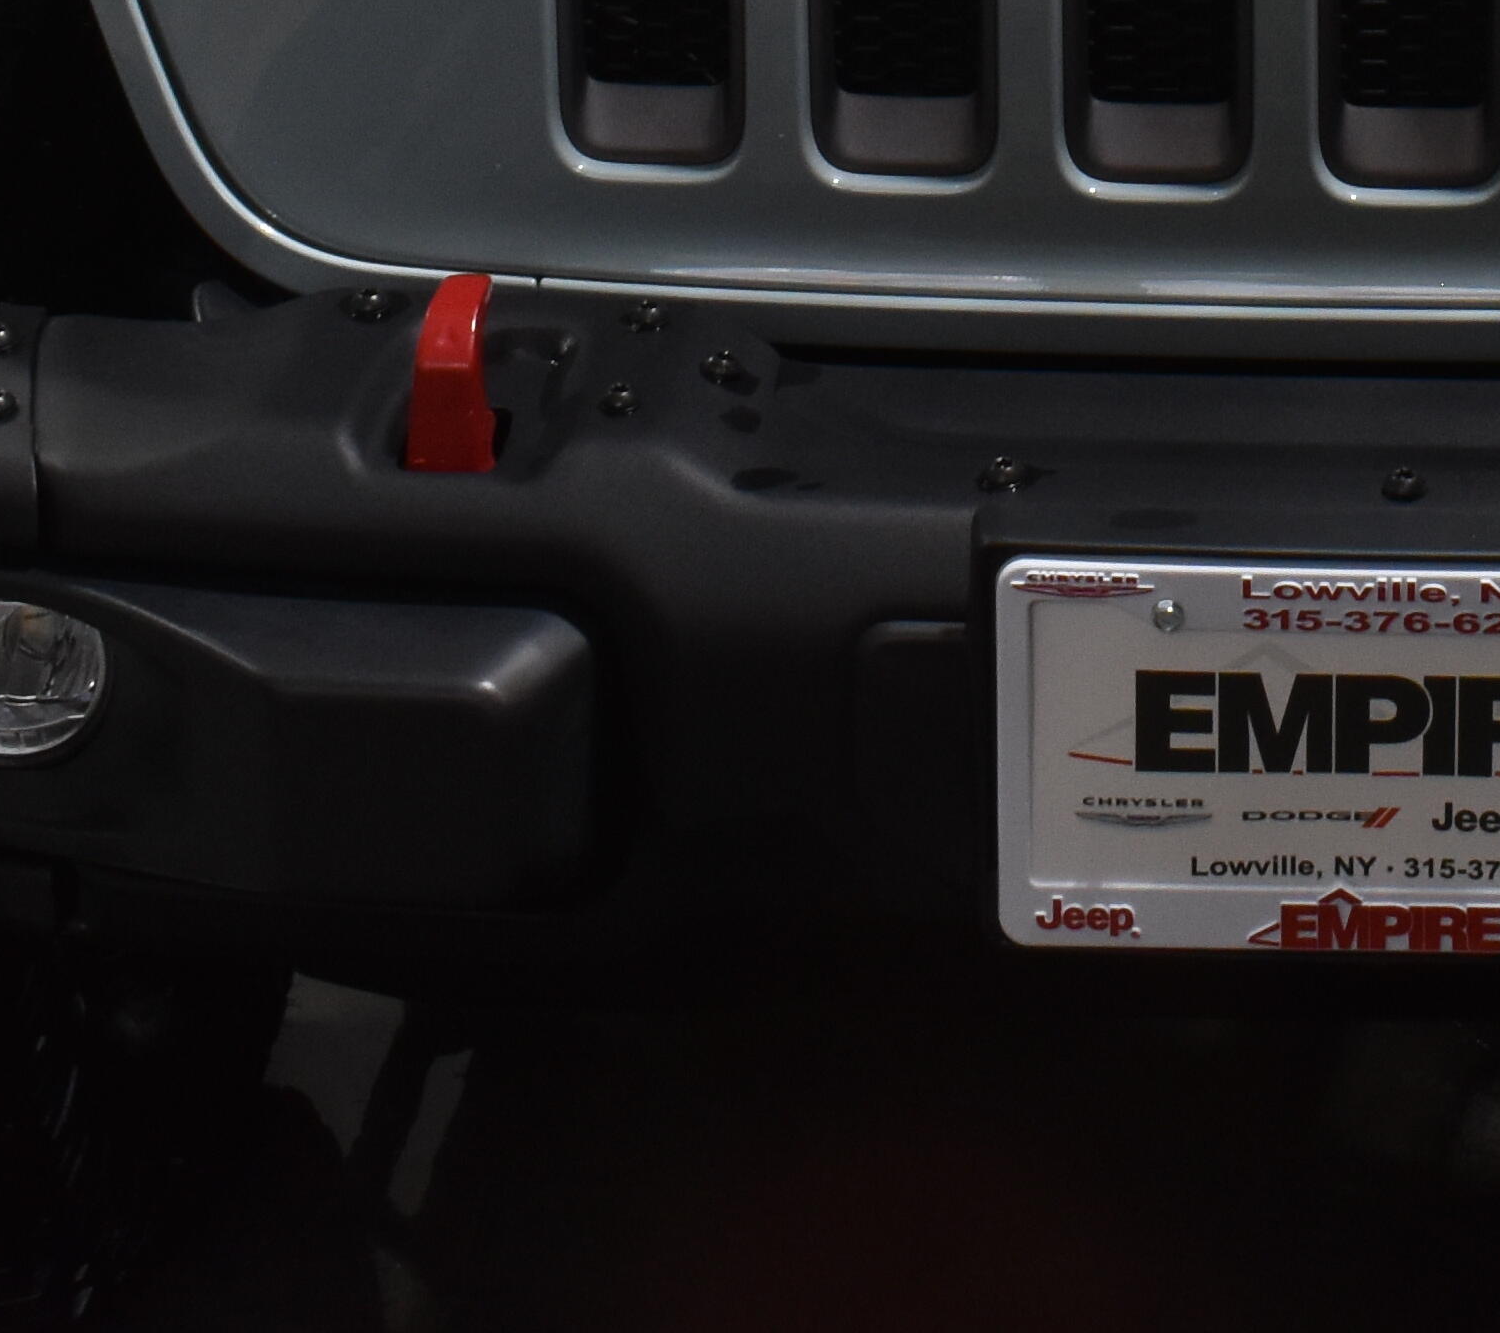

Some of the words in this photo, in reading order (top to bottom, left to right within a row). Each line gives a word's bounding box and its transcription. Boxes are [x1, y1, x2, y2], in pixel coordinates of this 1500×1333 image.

[1025, 572, 1139, 585] CHRYSLER
[1241, 576, 1462, 606] Lowville,
[1082, 796, 1205, 808] CHRYSLER
[1190, 855, 1324, 880] Lowville,
[1333, 856, 1378, 878] NY
[1035, 895, 1141, 939] Jeep
